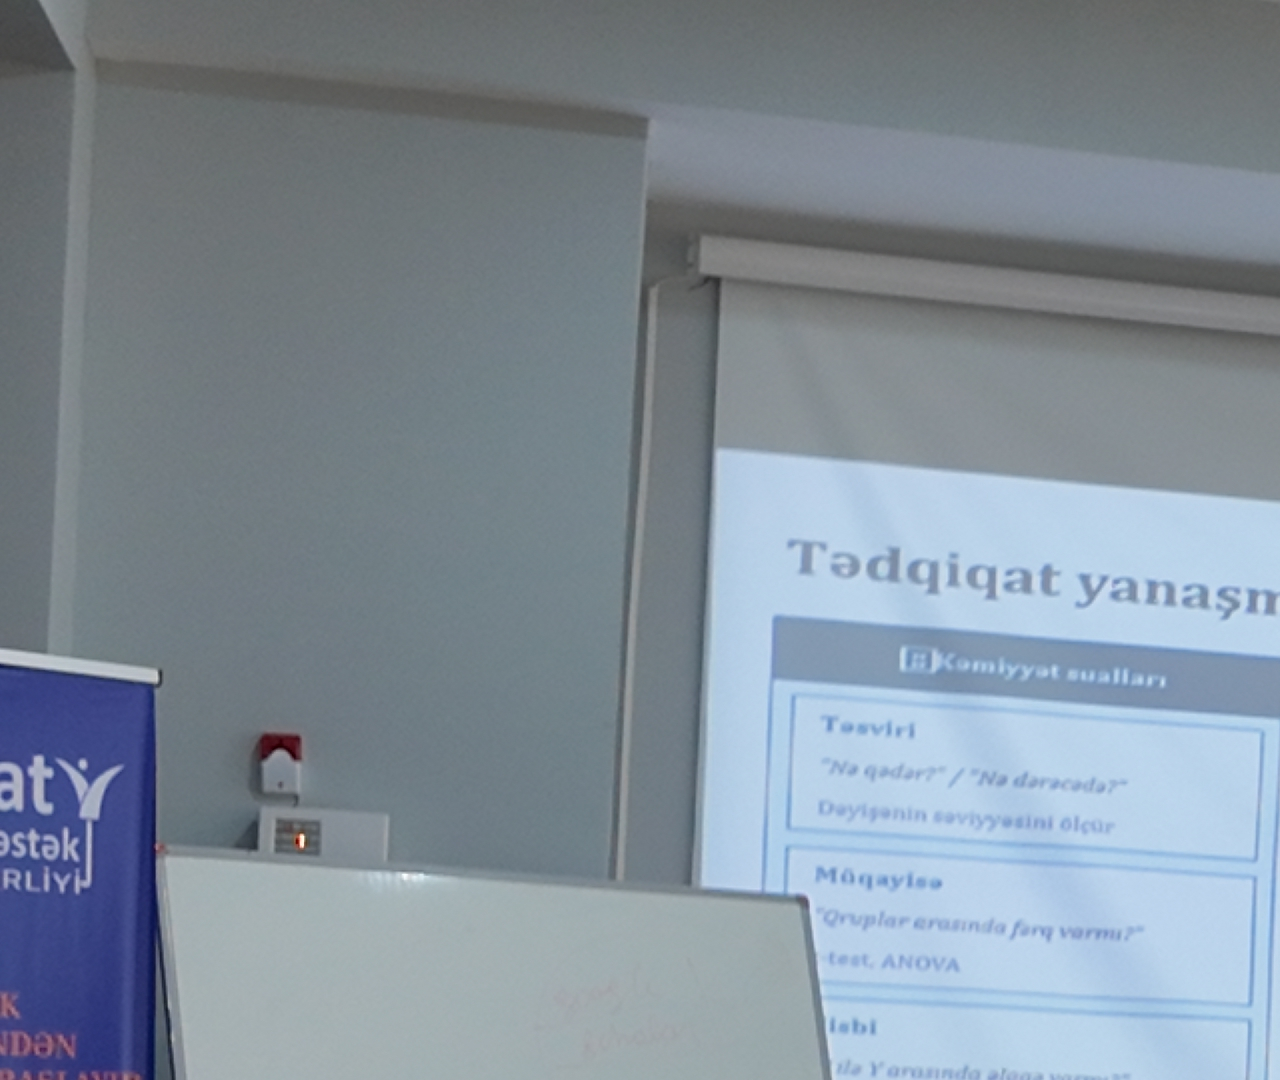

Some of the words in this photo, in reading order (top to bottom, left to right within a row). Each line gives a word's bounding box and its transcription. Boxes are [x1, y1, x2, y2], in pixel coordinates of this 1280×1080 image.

[788, 539, 1060, 598] Tədqiqat
[938, 651, 1060, 682] Kəmiyyət
[1067, 667, 1168, 690] sualları
[821, 715, 916, 740] Təsviri
[817, 799, 928, 826] Dəyişənin
[932, 805, 1055, 834] səviyyəsini
[1060, 814, 1116, 838] ölçür
[814, 865, 944, 893] Müqayisə
[881, 953, 961, 974] ANOVA
[827, 1016, 878, 1036] isbi
